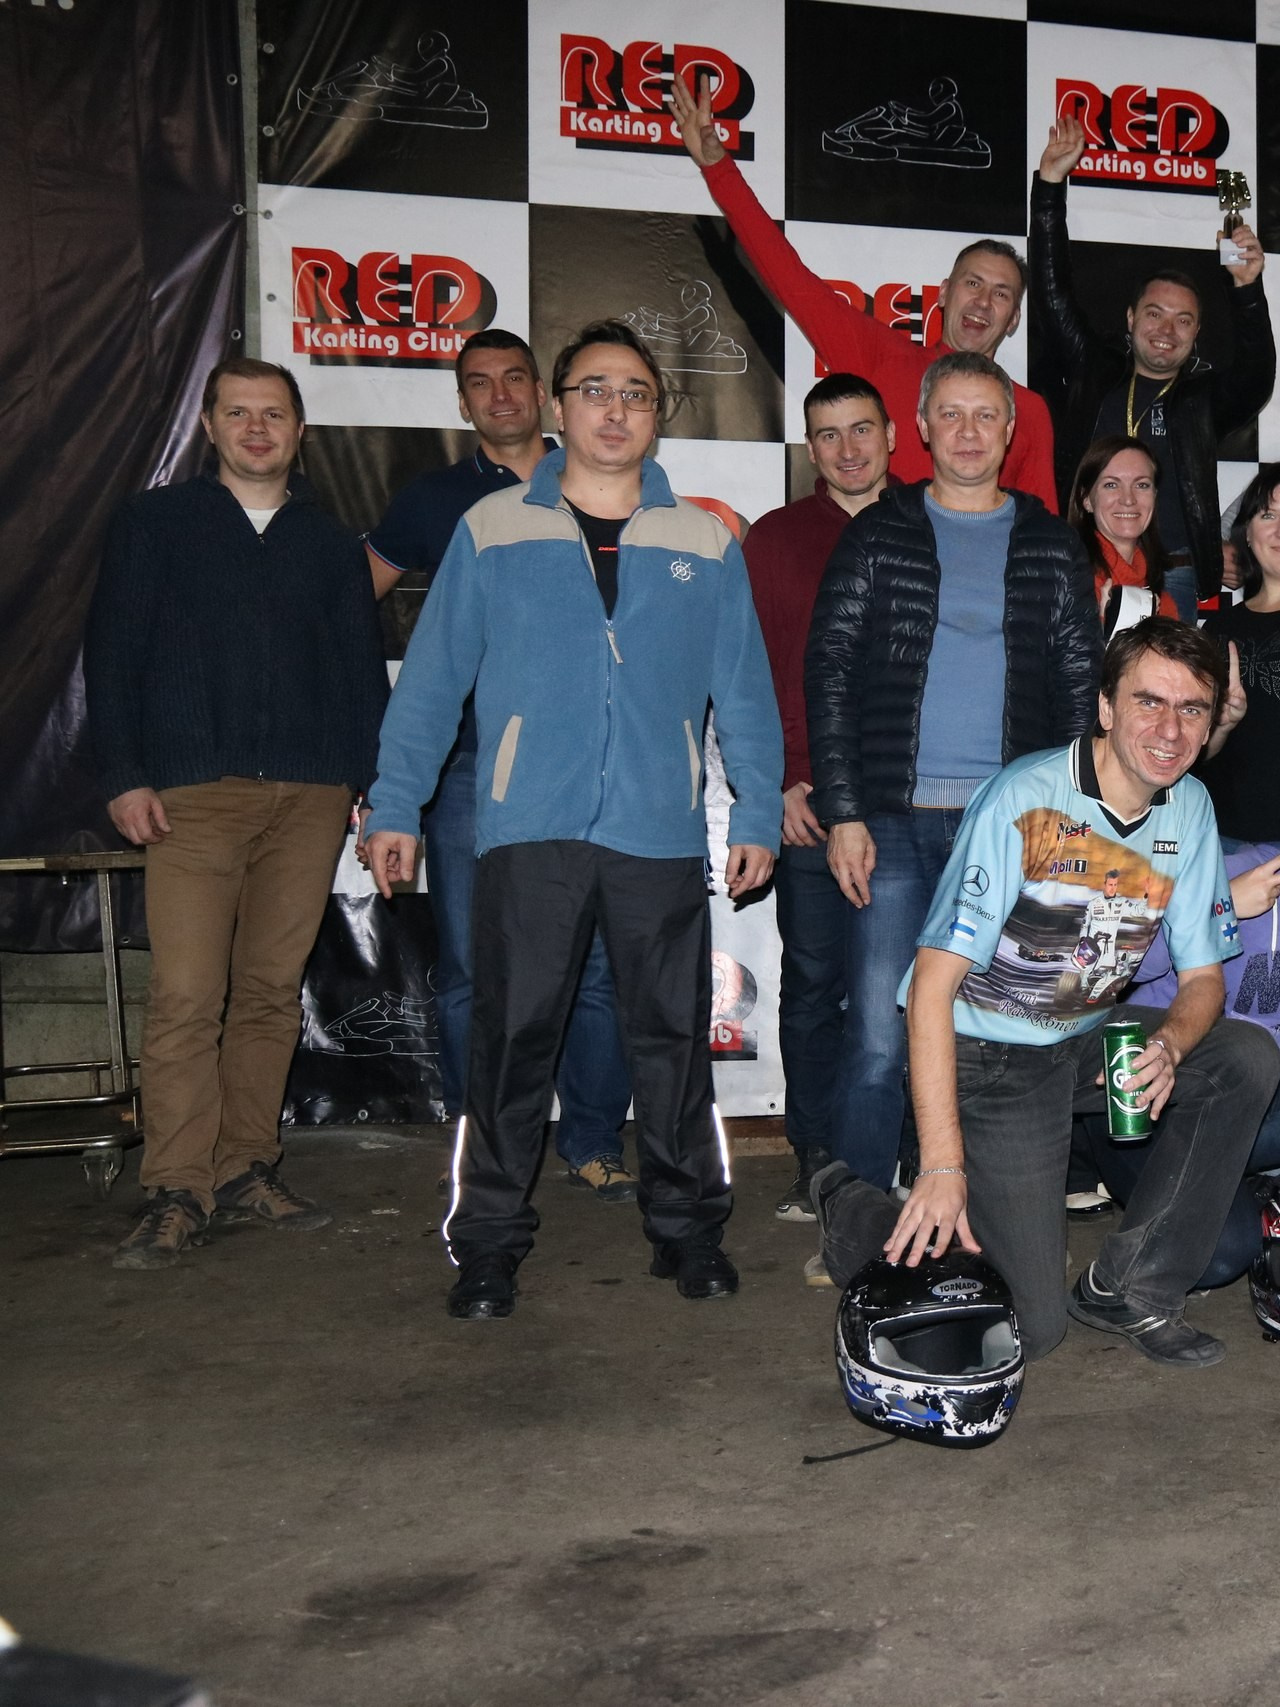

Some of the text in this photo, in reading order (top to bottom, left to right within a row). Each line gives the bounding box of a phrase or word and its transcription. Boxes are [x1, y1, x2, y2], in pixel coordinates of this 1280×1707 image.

[560, 33, 742, 113] RED
[570, 111, 662, 143] Karting
[1056, 78, 1217, 153] RED
[1076, 153, 1207, 180] arting Club
[292, 247, 483, 324] RED
[304, 327, 399, 355] Karting
[939, 1281, 978, 1292] TORNADO
